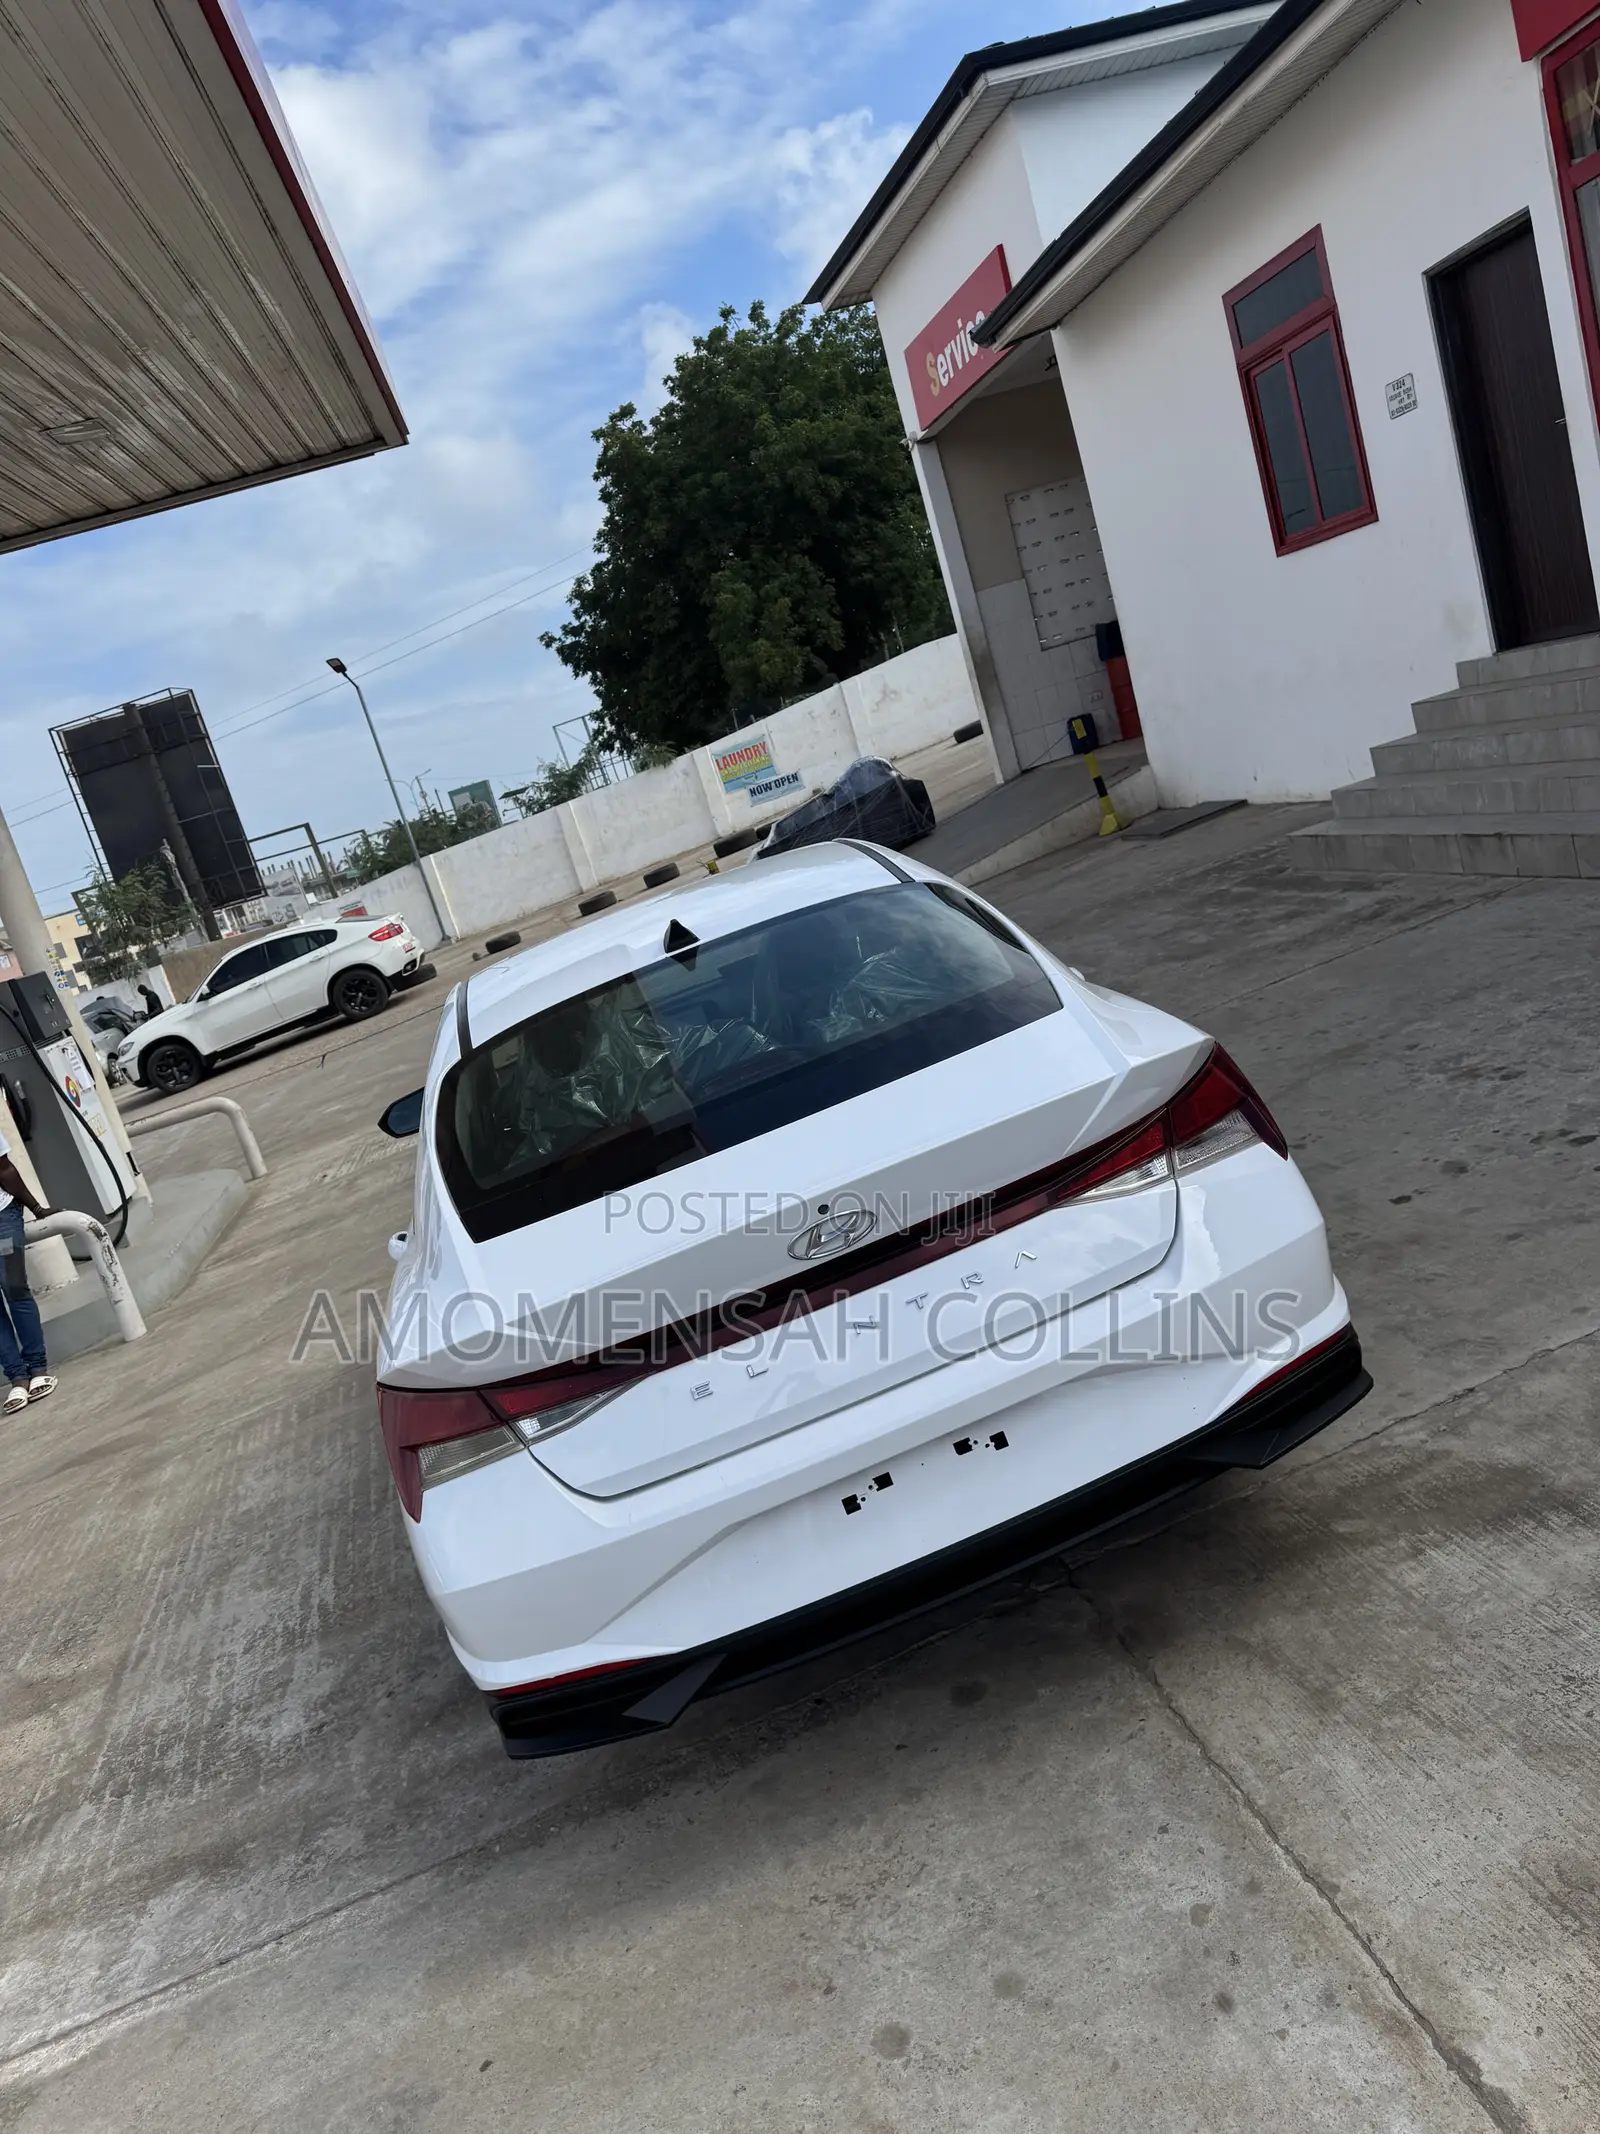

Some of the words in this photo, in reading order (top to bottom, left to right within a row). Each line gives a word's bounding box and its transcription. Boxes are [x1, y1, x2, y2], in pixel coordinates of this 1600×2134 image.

[715, 741, 768, 771] LAUNDRY
[749, 781, 773, 797] NOW
[773, 772, 799, 789] OPEN
